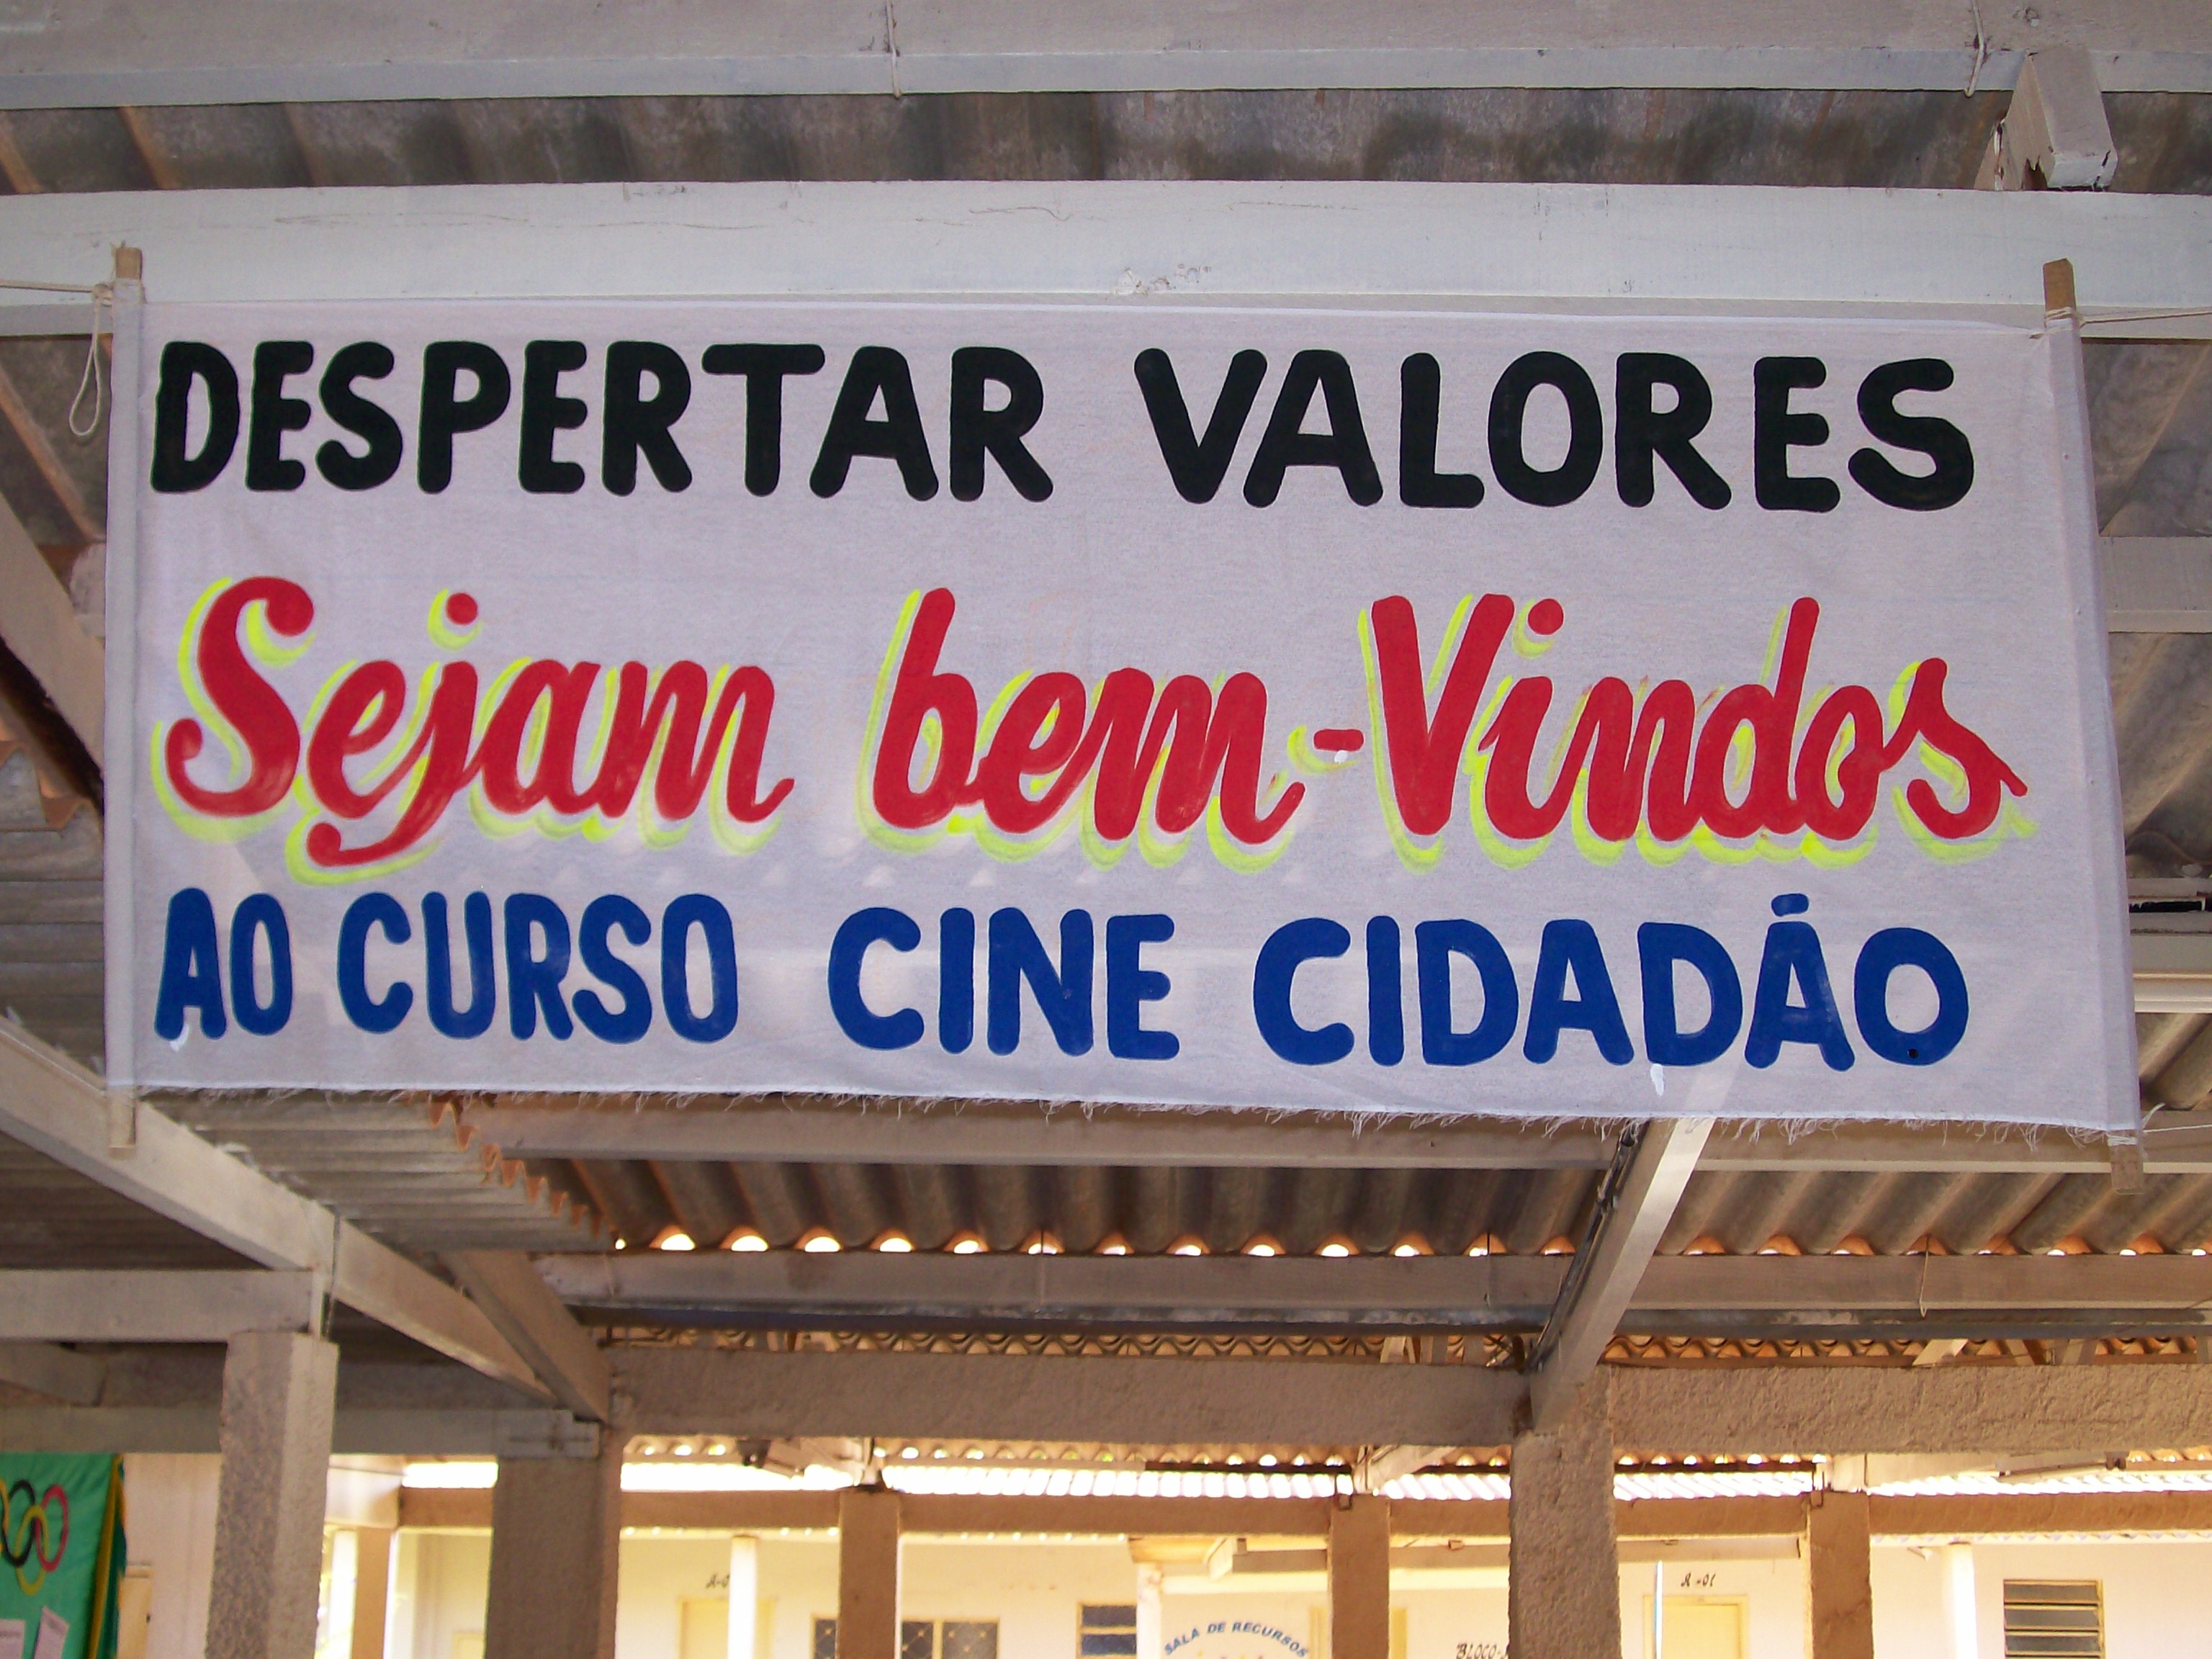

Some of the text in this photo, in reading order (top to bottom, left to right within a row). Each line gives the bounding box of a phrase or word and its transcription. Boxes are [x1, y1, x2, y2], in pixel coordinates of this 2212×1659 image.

[151, 341, 1974, 513] DESPERTAR VALORES
[166, 577, 794, 866] Sejam
[155, 888, 1969, 1071] AO CURSO CINE CIDADÃO
[1164, 1622, 1309, 1658] SALA DE RECURSOS
